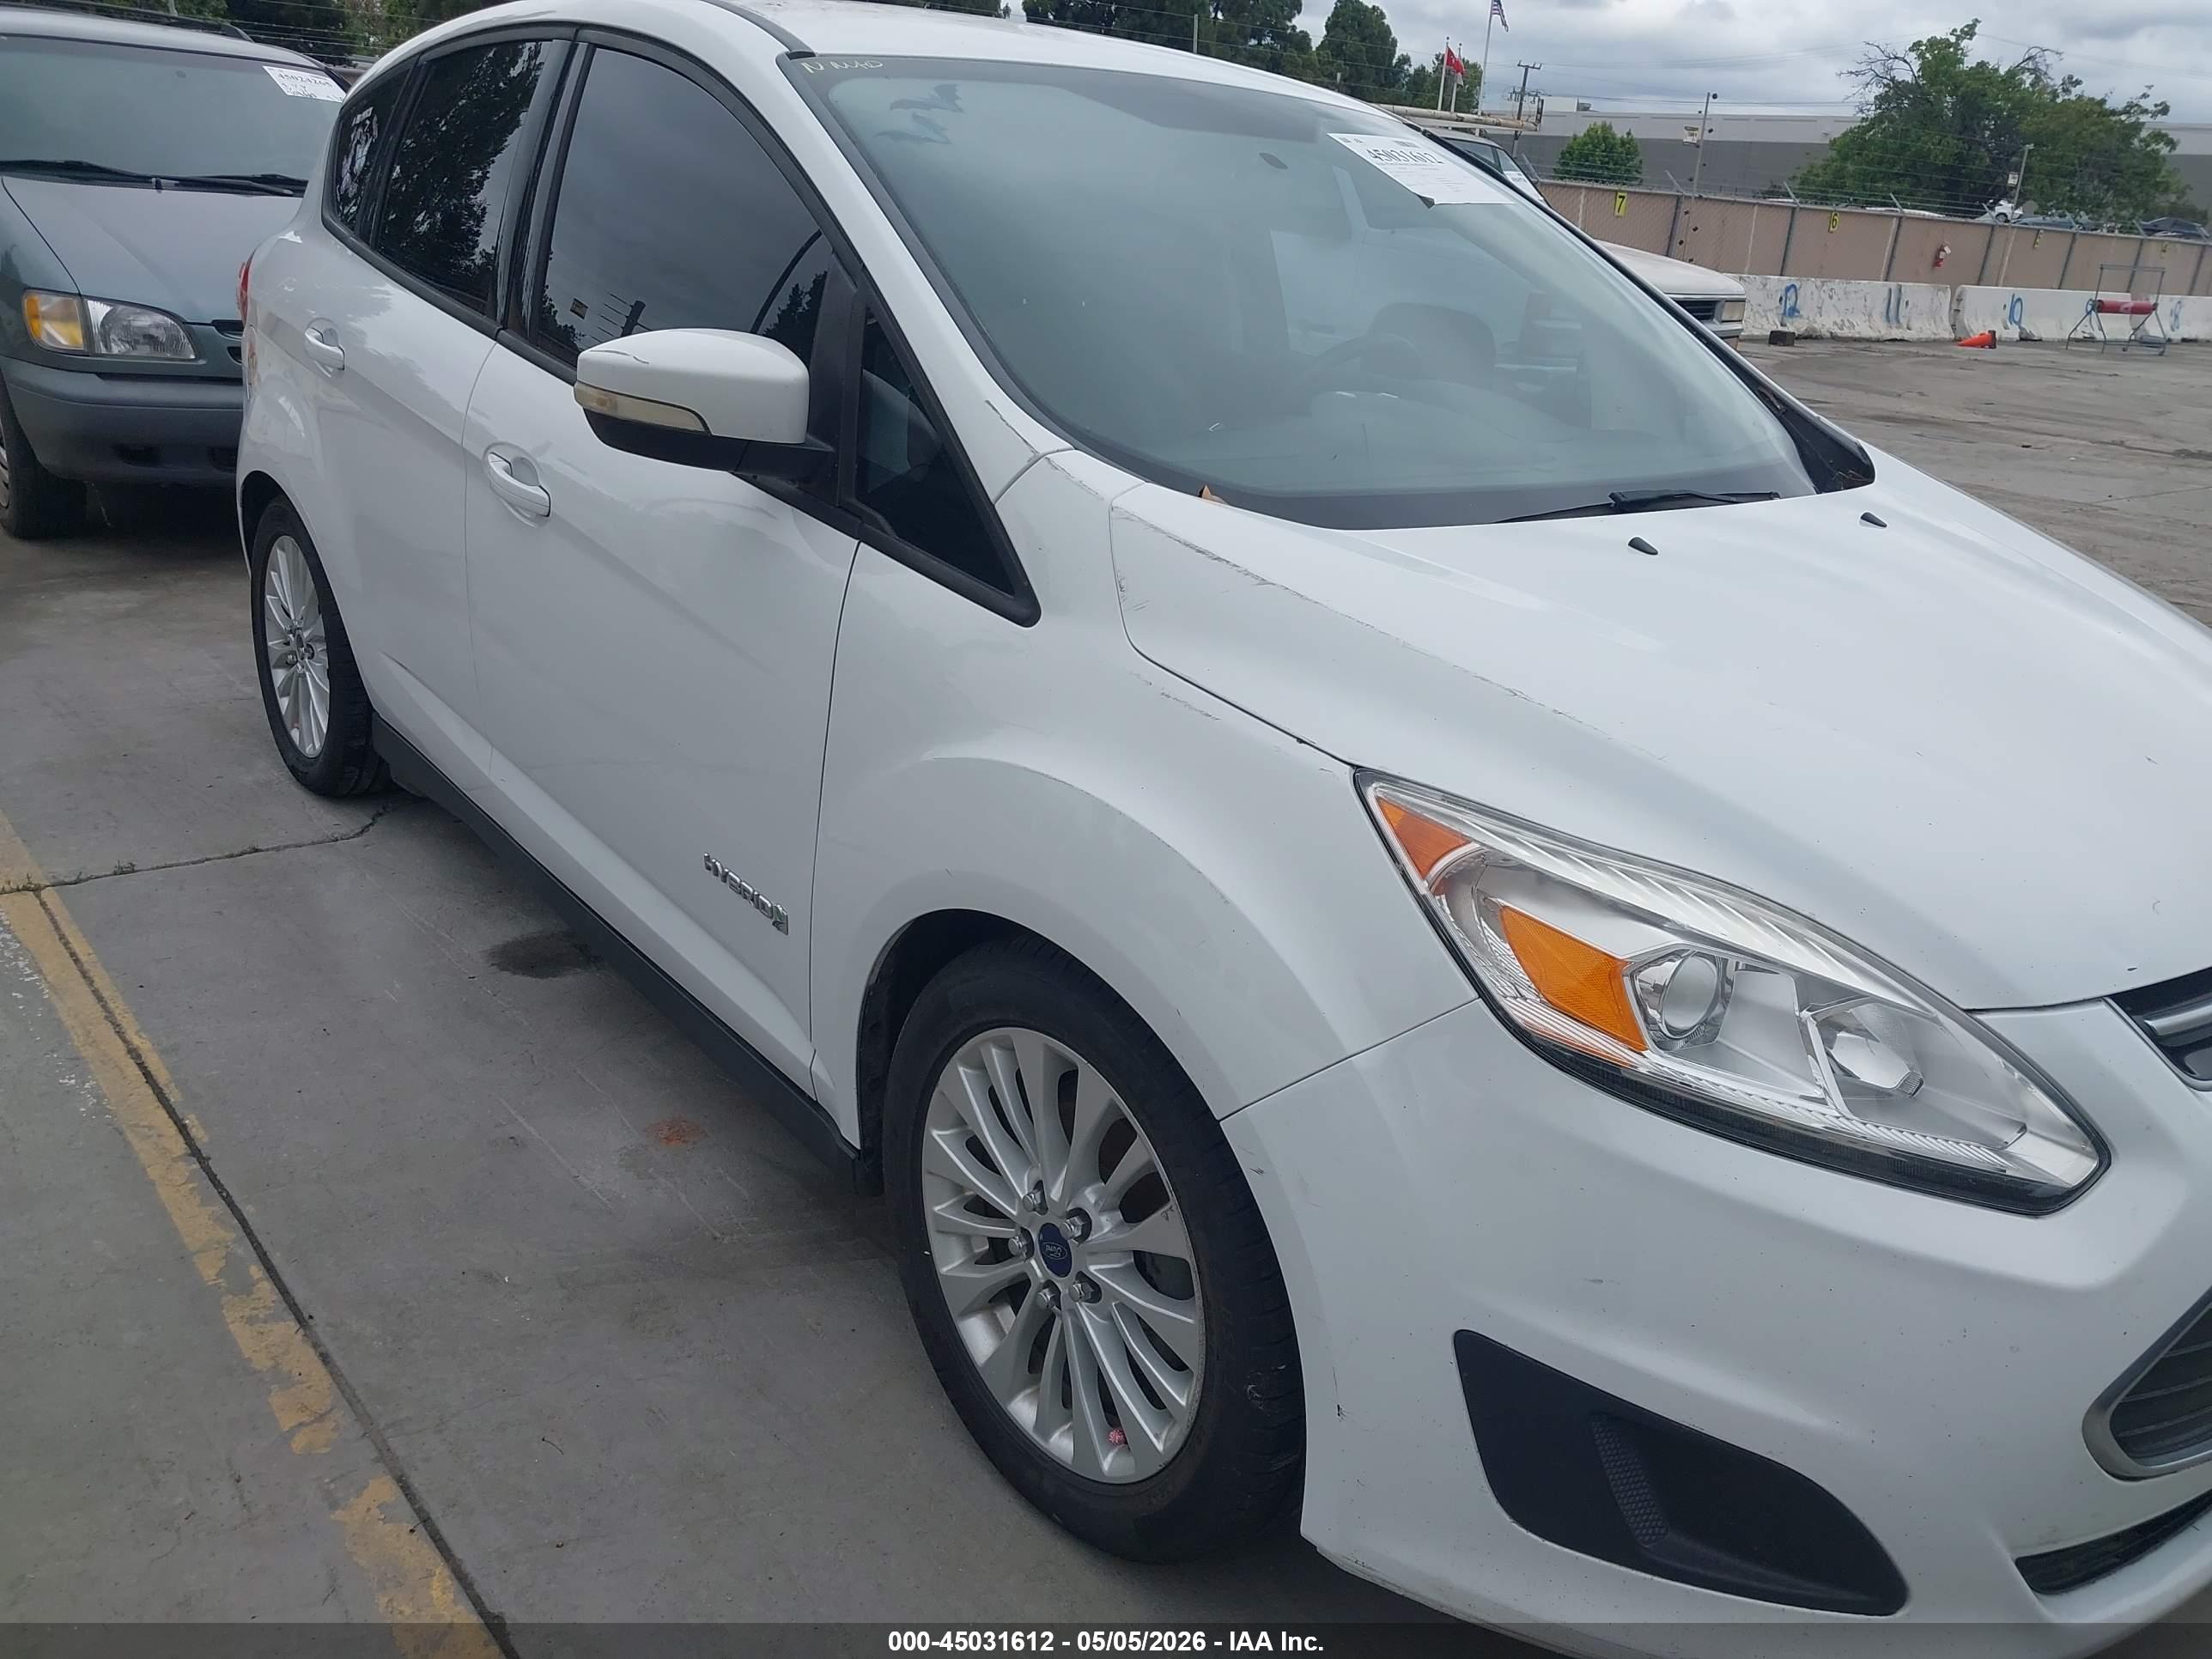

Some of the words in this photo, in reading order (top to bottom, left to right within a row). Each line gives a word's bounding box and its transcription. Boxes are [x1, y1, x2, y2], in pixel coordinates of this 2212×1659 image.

[1366, 148, 1444, 165] 45031612
[1617, 195, 1626, 215] 7
[1831, 212, 1839, 228] 6
[1784, 283, 1801, 318] 12
[1886, 283, 1903, 324] 11
[2008, 292, 2023, 326] 10
[704, 853, 774, 920] HYBRID
[1045, 1243, 1062, 1258] Ford
